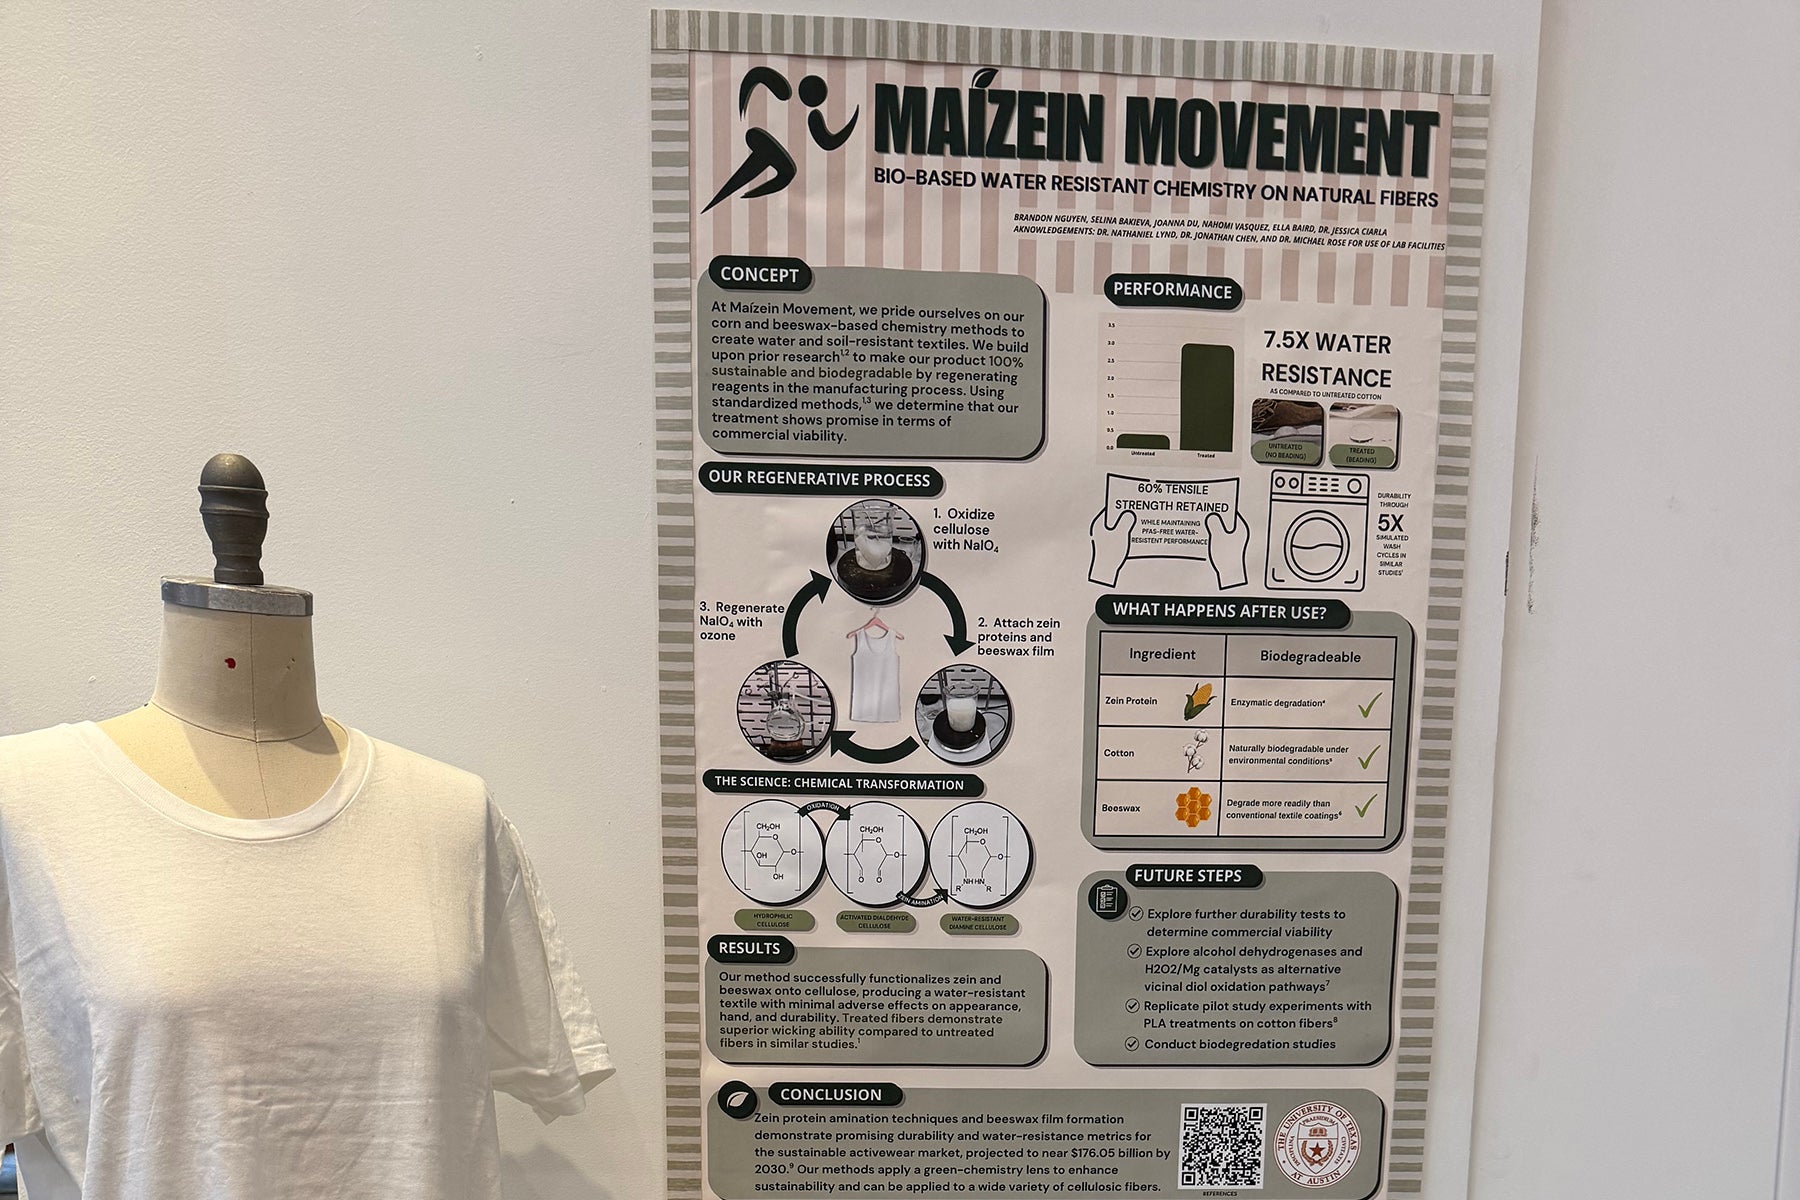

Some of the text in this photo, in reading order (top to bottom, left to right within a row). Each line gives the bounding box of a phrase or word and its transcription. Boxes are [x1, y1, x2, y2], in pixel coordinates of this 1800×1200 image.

[1125, 96, 1440, 178] MOVEMENT
[874, 167, 1439, 208] BIO-BASED WATER RESISTANT CHEMISTRY ON NATURAL FIBERS
[1014, 213, 1052, 222] BRANDON
[1054, 215, 1089, 226] NGUYEN,
[1091, 216, 1117, 224] SELINA
[1153, 219, 1185, 227] JOANNA
[1187, 219, 1200, 229] DU,
[1234, 223, 1271, 232] VASQUEZ,
[1292, 224, 1317, 234] BAIRD,
[1318, 225, 1331, 234] DR.
[1331, 227, 1360, 236] JESSICA
[1097, 228, 1109, 236] DR.
[1111, 229, 1154, 238] NATHANIEL
[1156, 231, 1178, 239] LYND,
[1180, 231, 1193, 239] DR.
[1193, 232, 1234, 242] JONATHAN
[1235, 235, 1259, 243] CHEN,
[1279, 235, 1291, 243] DR.
[1293, 236, 1325, 246] MICHAEL
[1327, 238, 1346, 246] ROSE
[1348, 239, 1363, 247] FOR
[1380, 240, 1390, 248] OF
[1392, 241, 1406, 249] LAB
[1408, 241, 1445, 251] FACILITIES
[721, 266, 799, 283] CONCEPT
[1114, 282, 1232, 299] PERFORMANCE
[711, 301, 1025, 322] At Maízein Movement, we pride ourselves on our
[1264, 330, 1391, 354] 7.5X WATER
[1262, 363, 1392, 388] RESISTANCE
[1279, 388, 1312, 397] COMPARED
[712, 429, 847, 444] commercial viability.
[1269, 443, 1303, 451] UNTREATED
[709, 469, 930, 487] OUR REGENERATIVE PROCESS
[1138, 483, 1208, 495] 60% TENSILE
[1115, 499, 1229, 513] STRENGTH RETAINED
[933, 508, 995, 520] 1. Oxidize
[933, 523, 990, 535] cellulose
[1378, 513, 1404, 532] 5X
[933, 538, 960, 550] with
[1113, 602, 1327, 619] WHAT HAPPENS AFTER USE?
[1130, 648, 1196, 662] Ingredient
[1261, 650, 1361, 665] Biodegradeable
[1105, 696, 1157, 705] Zein Protein
[1104, 749, 1134, 757] Cotton
[715, 776, 964, 790] THE SCIENCE: CHEMICAL TRANSFORMATION
[1102, 804, 1140, 812] Beeswax
[1135, 869, 1242, 882] FUTURE STEPS
[1148, 908, 1346, 922] Explore further durability tests to
[719, 942, 780, 954] RESULTS
[719, 971, 1001, 987] Our method successfully functionalizes zein and
[1145, 1039, 1336, 1052] Conduct biodegredation studies
[781, 1088, 881, 1101] CONCLUSION
[754, 1113, 1124, 1126] Zein protein amination techniques and beeswax film formation
[1278, 1104, 1357, 1151] THE UNIVERSITY OF TEXAS
[1291, 1170, 1341, 1185] AT AUSTIN
